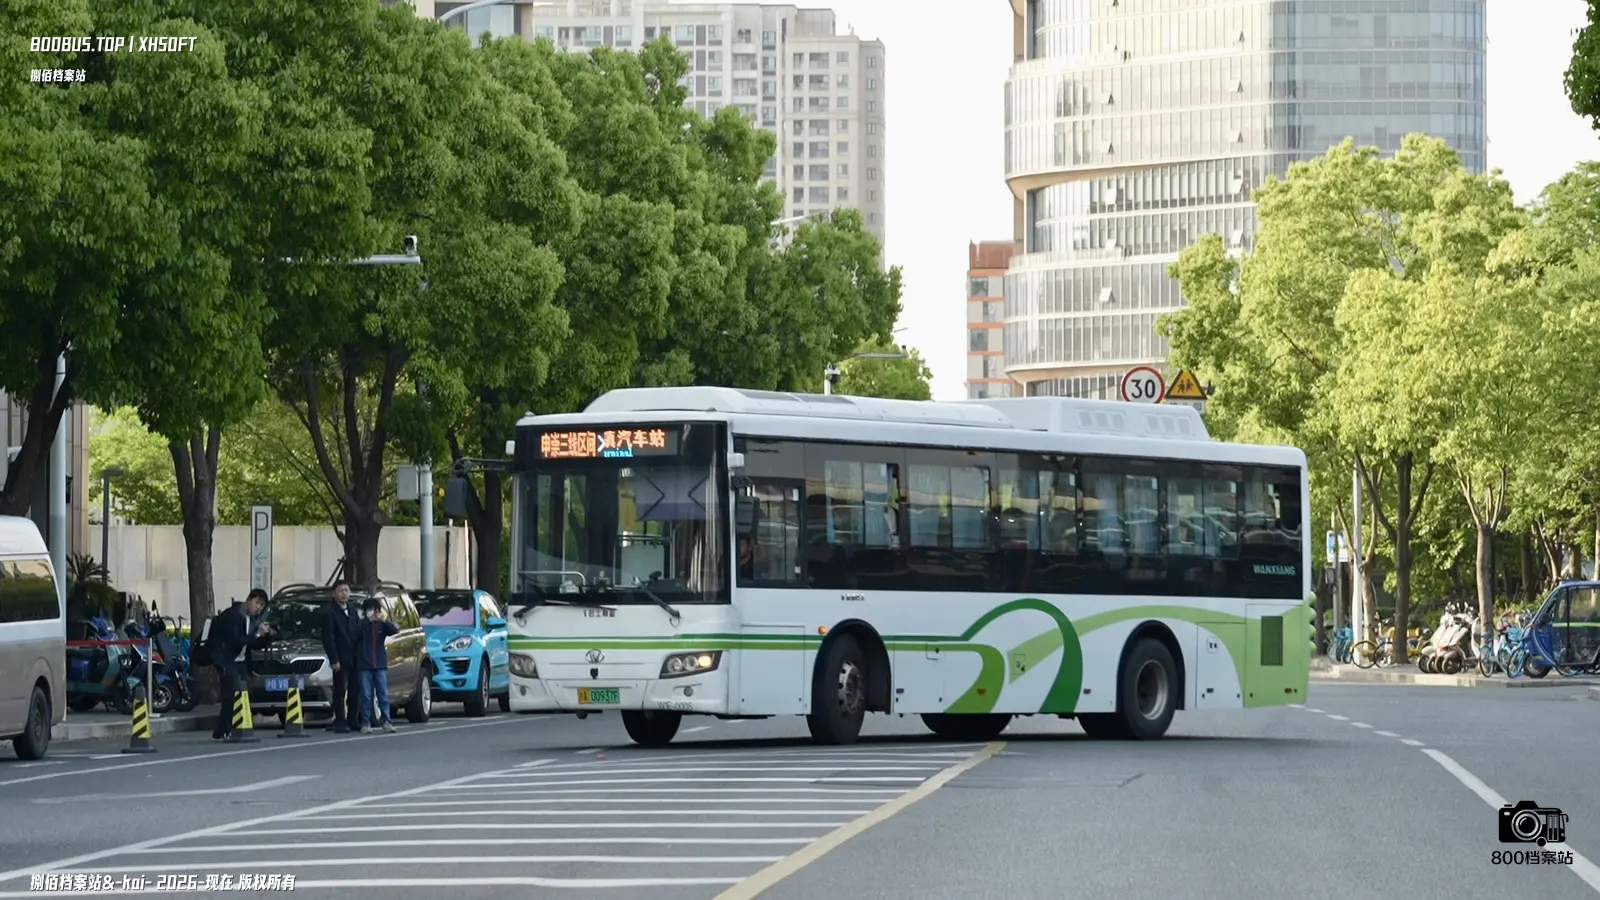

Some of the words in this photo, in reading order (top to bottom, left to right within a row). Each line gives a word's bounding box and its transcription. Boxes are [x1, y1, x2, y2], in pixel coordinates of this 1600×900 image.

[1131, 379, 1156, 399] 30
[254, 511, 269, 547] P
[1252, 564, 1296, 576] WANXIANG
